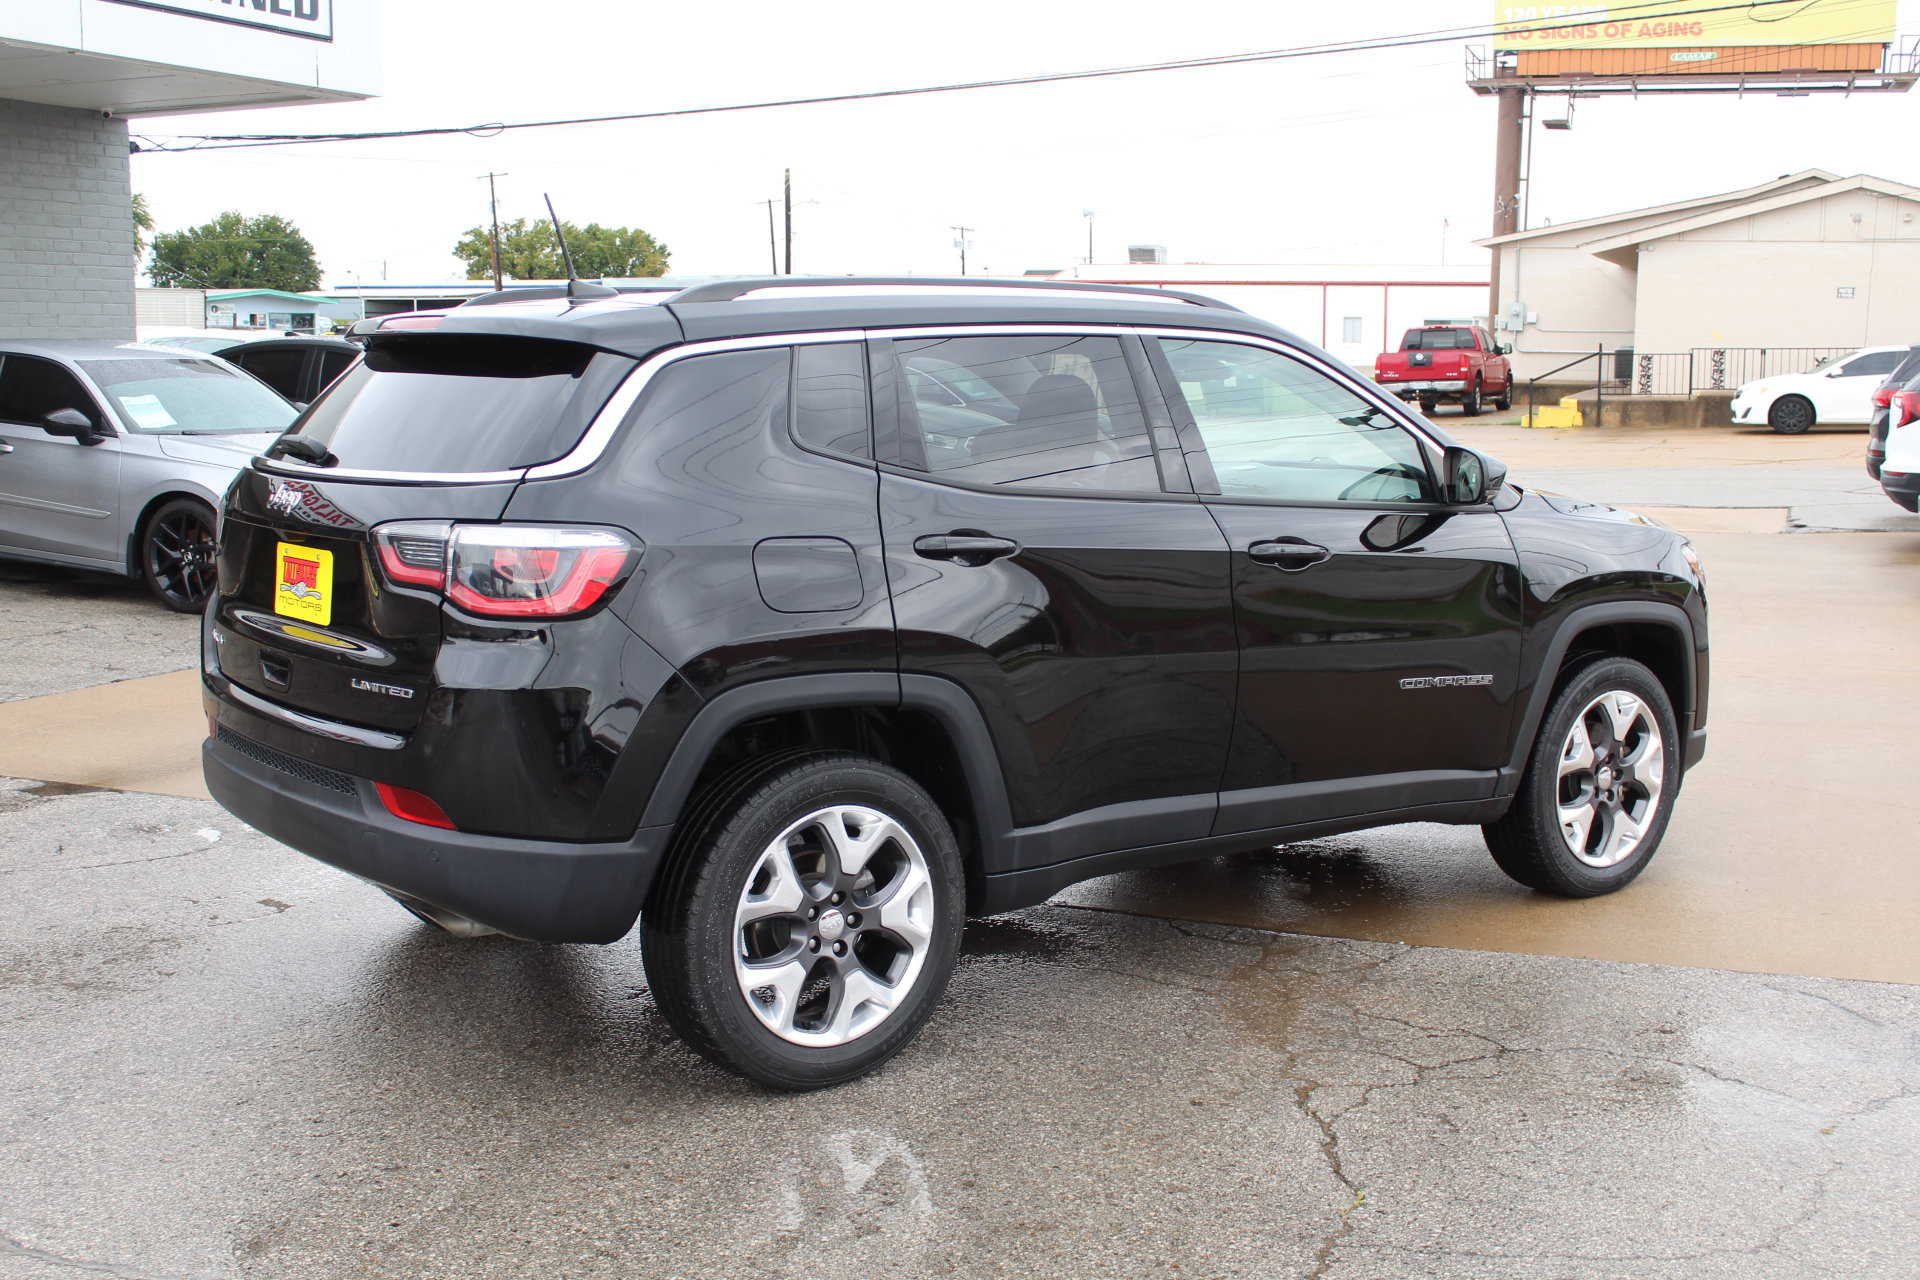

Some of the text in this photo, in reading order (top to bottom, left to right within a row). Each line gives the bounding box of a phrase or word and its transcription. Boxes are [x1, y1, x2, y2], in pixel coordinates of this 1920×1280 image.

[1503, 5, 1608, 22] 120 YEARS
[1503, 21, 1704, 40] NO SIGNS OF AGING
[1674, 52, 1713, 61] LAMAR
[267, 483, 302, 515] Jeep
[279, 595, 322, 612] MOTORS
[351, 678, 414, 698] LIMITED
[1400, 674, 1494, 689] COMPASS
